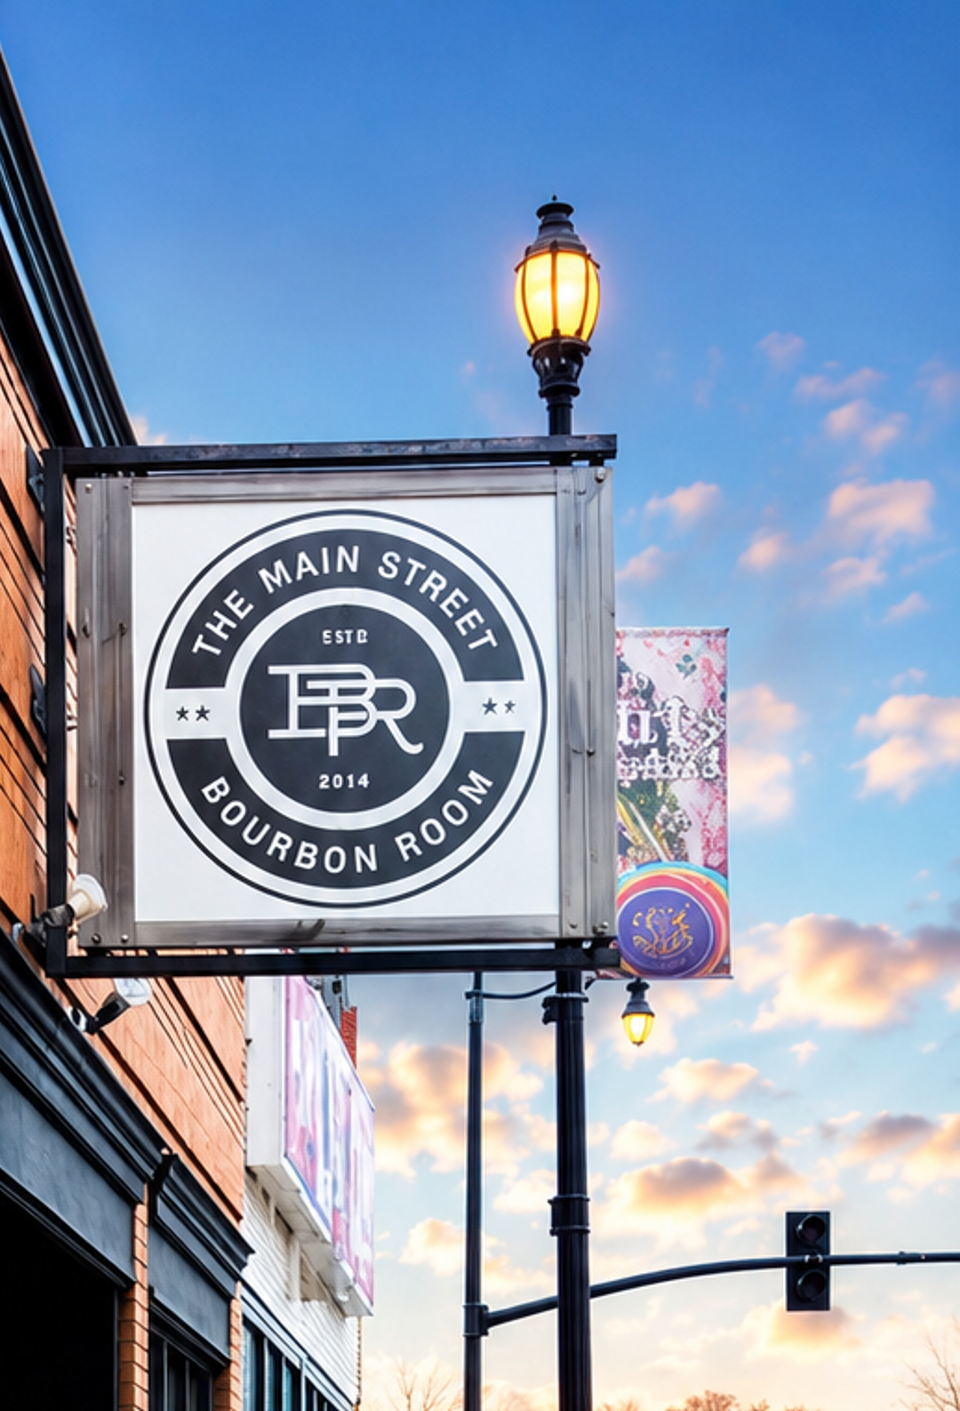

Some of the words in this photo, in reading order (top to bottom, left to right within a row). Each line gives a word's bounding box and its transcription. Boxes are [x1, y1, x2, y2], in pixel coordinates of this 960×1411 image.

[192, 589, 254, 657] THE
[258, 545, 360, 594] MAIN
[377, 551, 498, 653] STREET
[201, 776, 378, 874] BOURBON
[394, 769, 493, 862] ROOM
[319, 773, 370, 789] 2014
